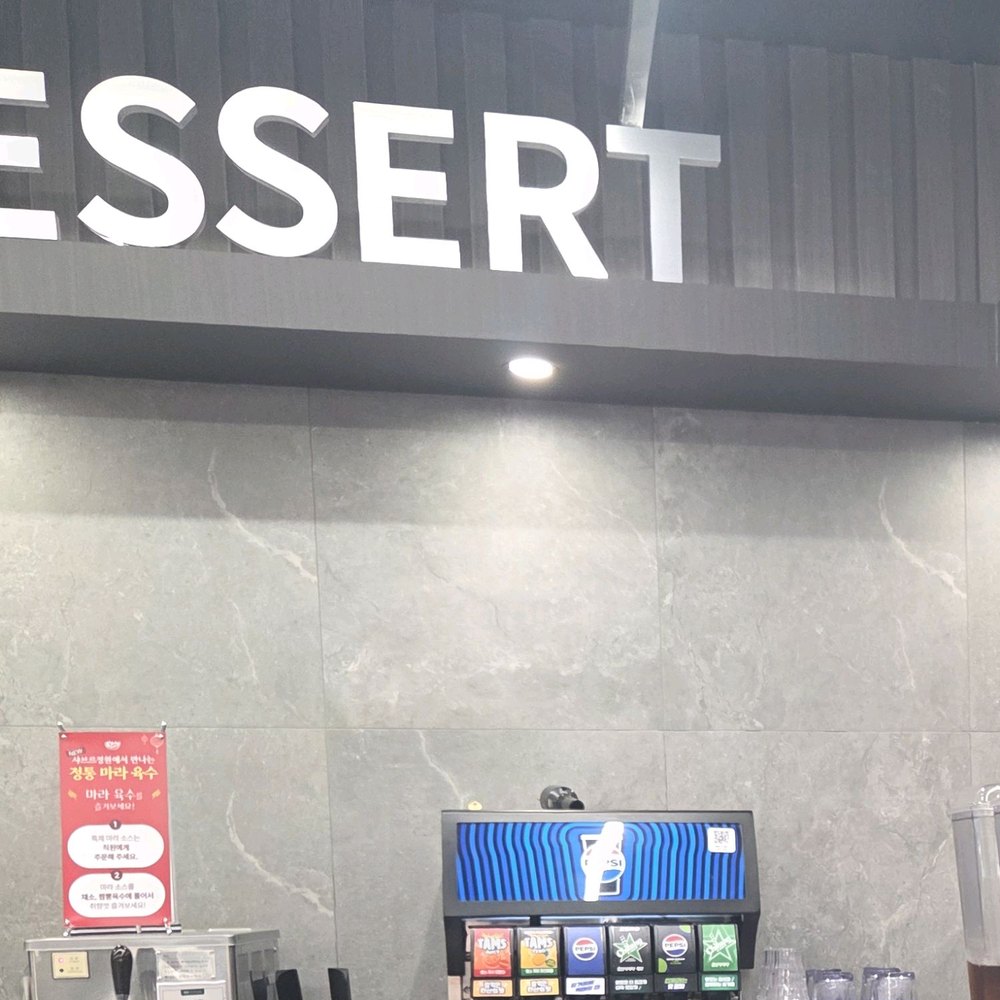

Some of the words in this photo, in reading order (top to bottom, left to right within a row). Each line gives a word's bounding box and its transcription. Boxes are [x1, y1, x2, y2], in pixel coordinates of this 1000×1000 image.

[69, 765, 97, 781] 정통
[100, 765, 129, 780] 마라
[131, 765, 159, 780] 육수
[85, 788, 110, 800] 마라
